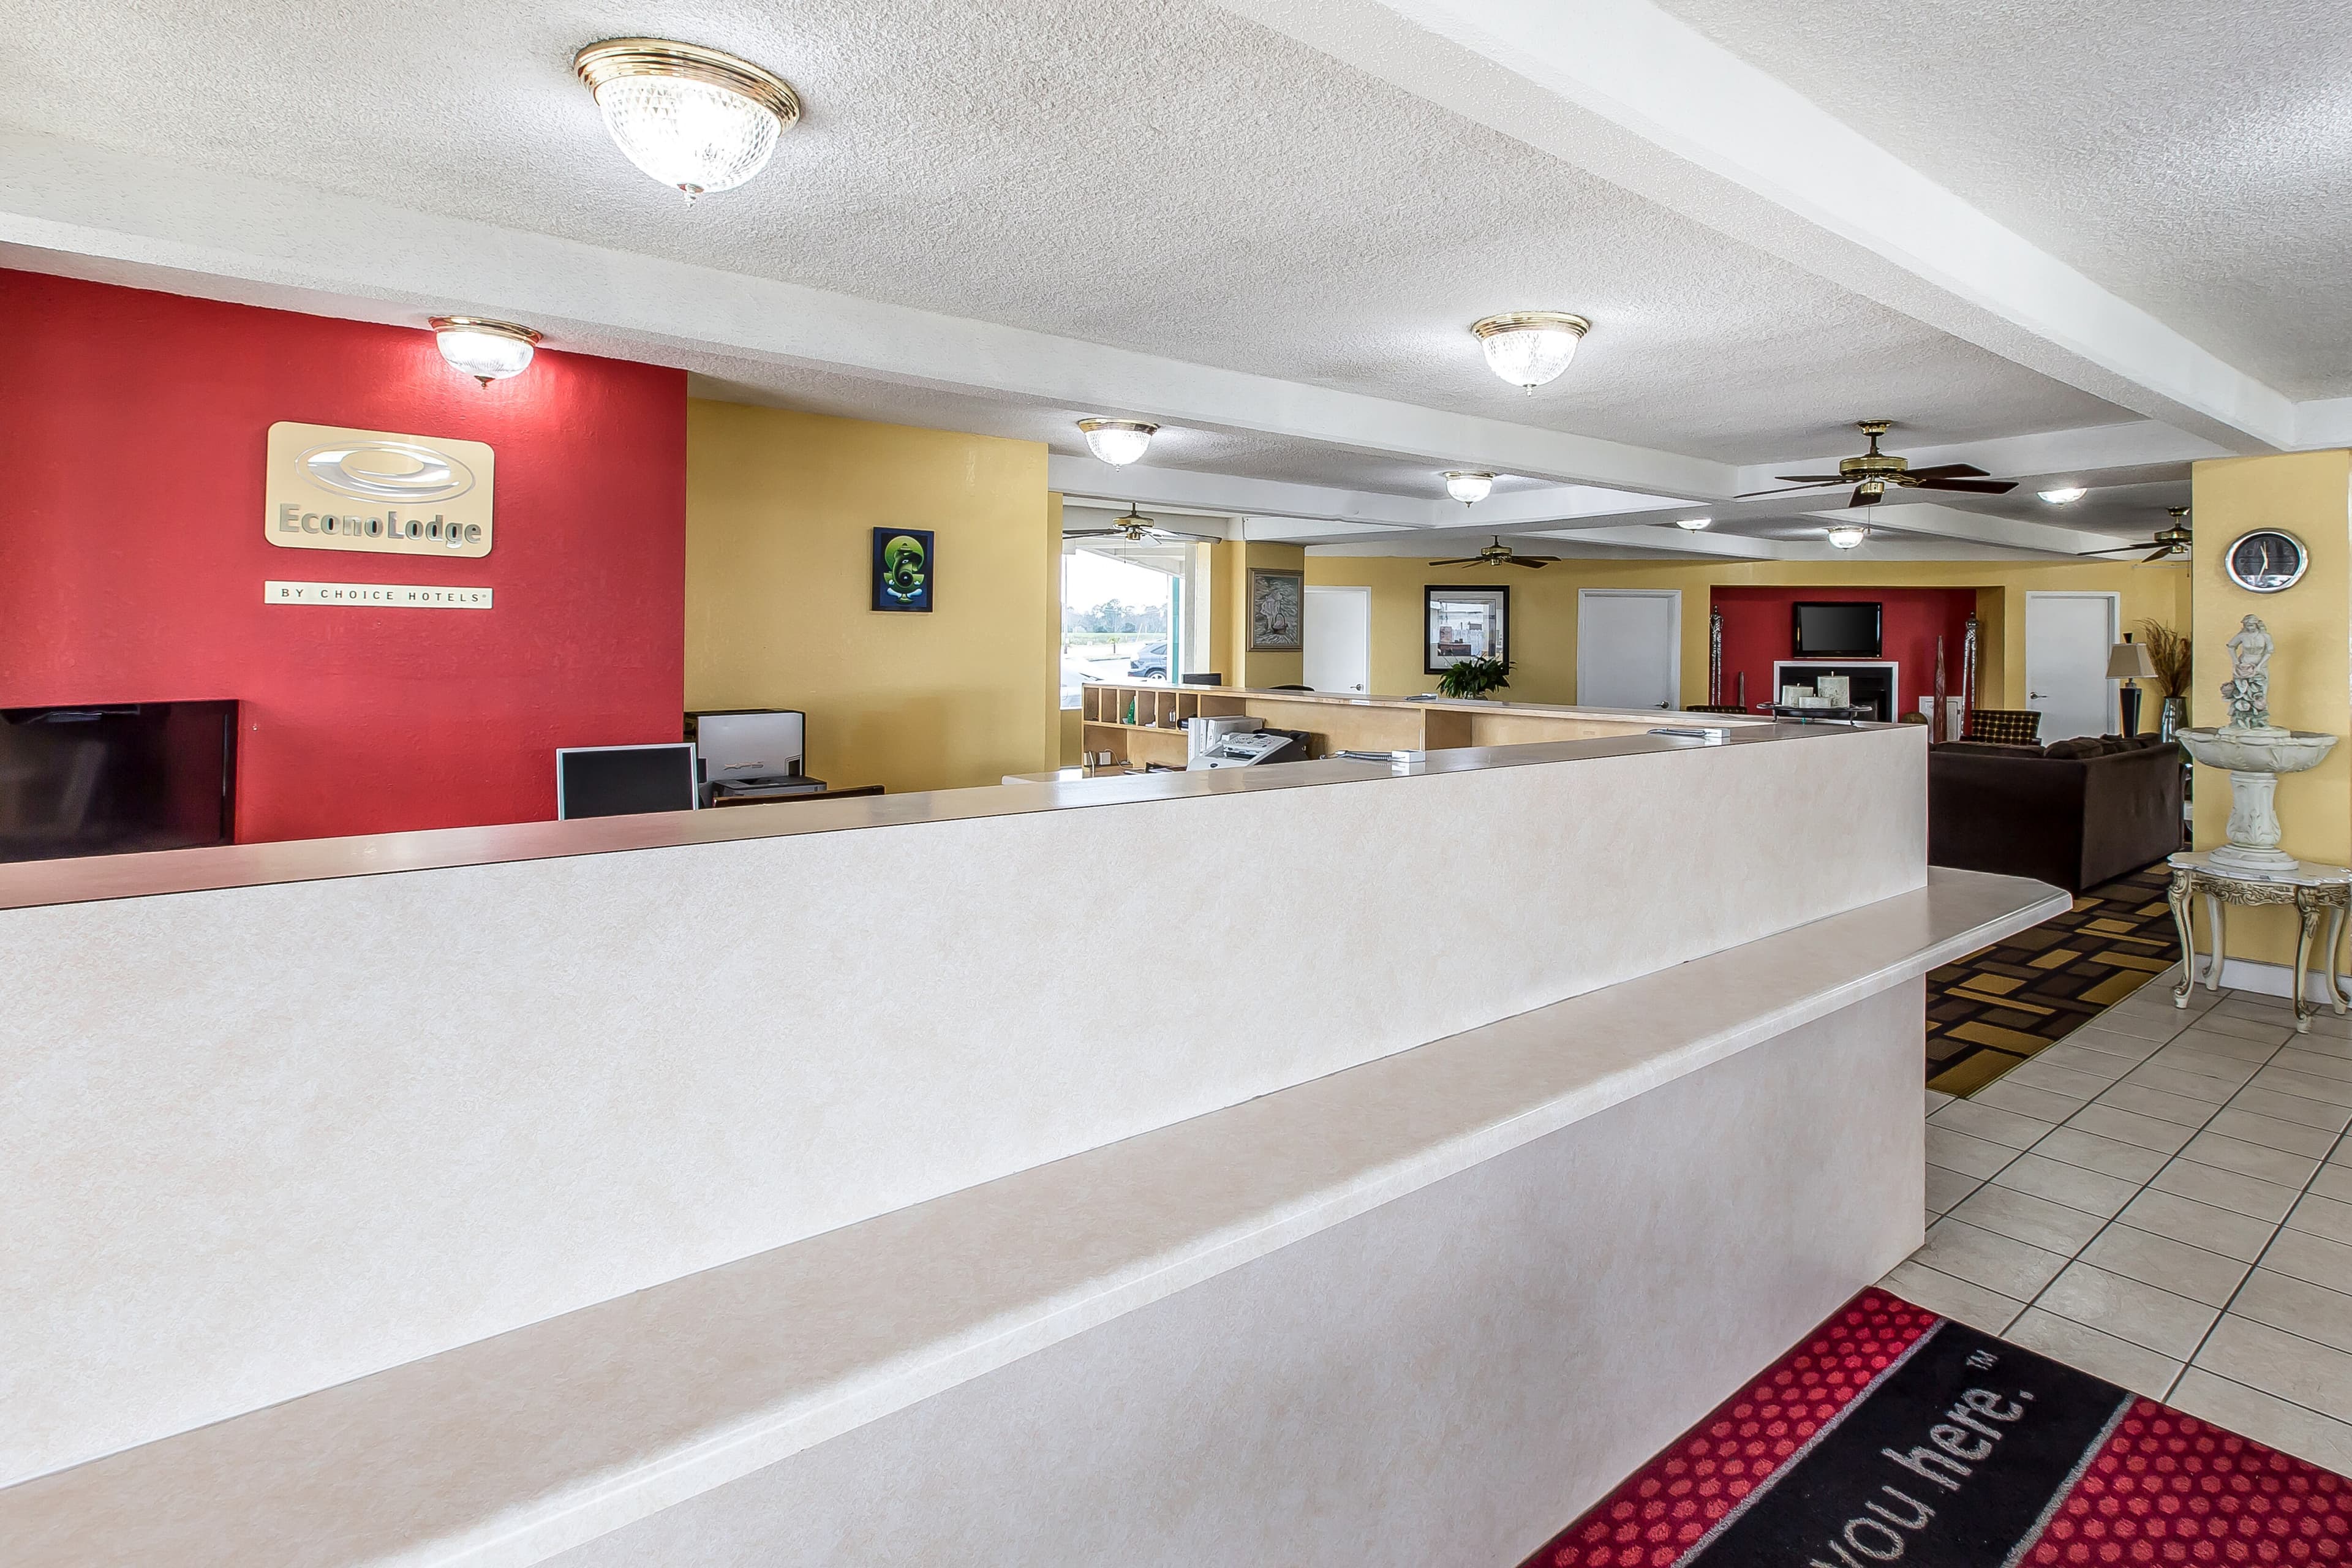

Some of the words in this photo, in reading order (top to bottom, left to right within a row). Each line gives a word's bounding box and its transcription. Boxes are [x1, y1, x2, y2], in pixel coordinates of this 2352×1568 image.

[280, 503, 481, 548] EconoLodge
[282, 588, 304, 598] BY
[320, 589, 394, 600] CHOICE
[408, 592, 479, 603] HOTELS
